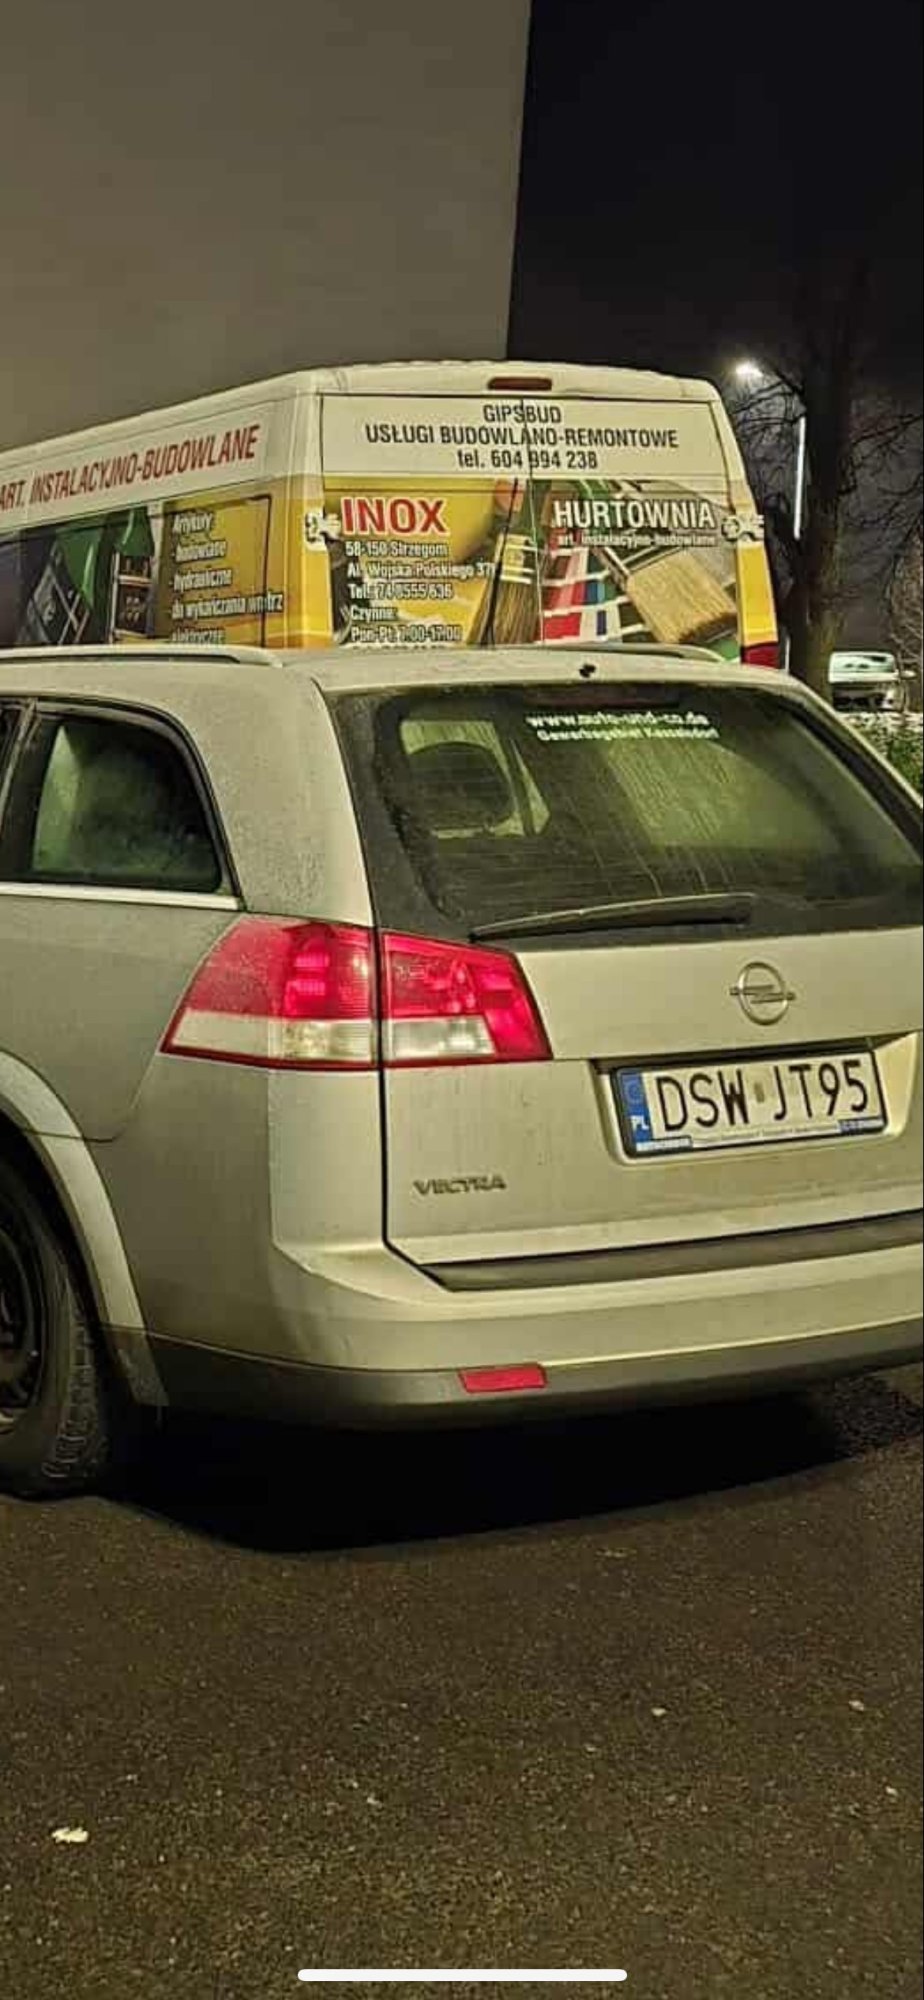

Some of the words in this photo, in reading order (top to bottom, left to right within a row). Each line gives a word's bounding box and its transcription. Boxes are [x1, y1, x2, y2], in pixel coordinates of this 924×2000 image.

[482, 404, 562, 424] GIPSBUD
[365, 423, 435, 445] USŁUGI
[440, 424, 679, 449] BUDOWLANO-REMONTOWE
[30, 424, 260, 506] INSTALACYJNO-BUDOWLANE
[458, 450, 486, 468] tel.
[490, 450, 523, 469] 604
[566, 451, 599, 470] 238
[341, 497, 448, 535] INOX
[553, 500, 716, 529] HURTOWNIA
[391, 541, 448, 559] Strzegom
[655, 1069, 750, 1133] DSW
[773, 1059, 870, 1122] JT95
[630, 1114, 651, 1132] PL
